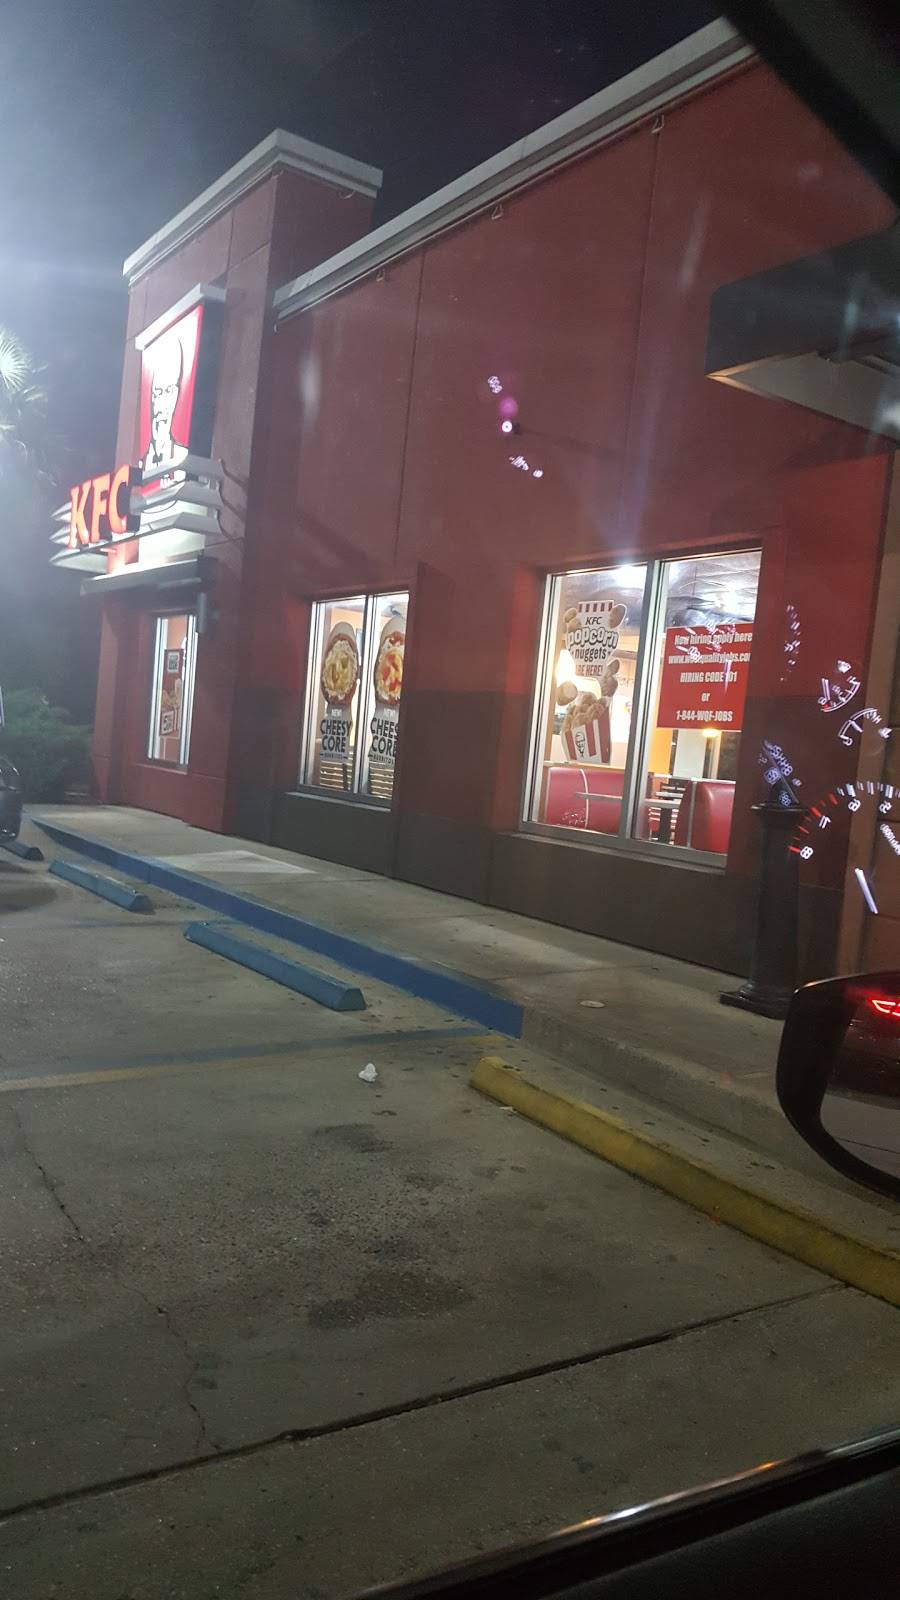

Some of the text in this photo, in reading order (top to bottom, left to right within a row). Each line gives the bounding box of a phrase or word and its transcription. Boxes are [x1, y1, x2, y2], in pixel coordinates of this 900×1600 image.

[68, 464, 130, 549] KFC
[585, 616, 602, 625] KFC
[567, 627, 619, 651] popcorn
[691, 633, 712, 645] hiring
[713, 633, 735, 644] apply
[735, 632, 753, 642] here
[575, 648, 606, 662] nuggets
[680, 671, 704, 683] HIRING
[705, 671, 724, 683] CODE
[701, 692, 711, 702] or
[676, 710, 733, 722] 1-844-WQF-JOBS
[320, 719, 352, 737] CHEESY
[322, 735, 346, 753] CORE
